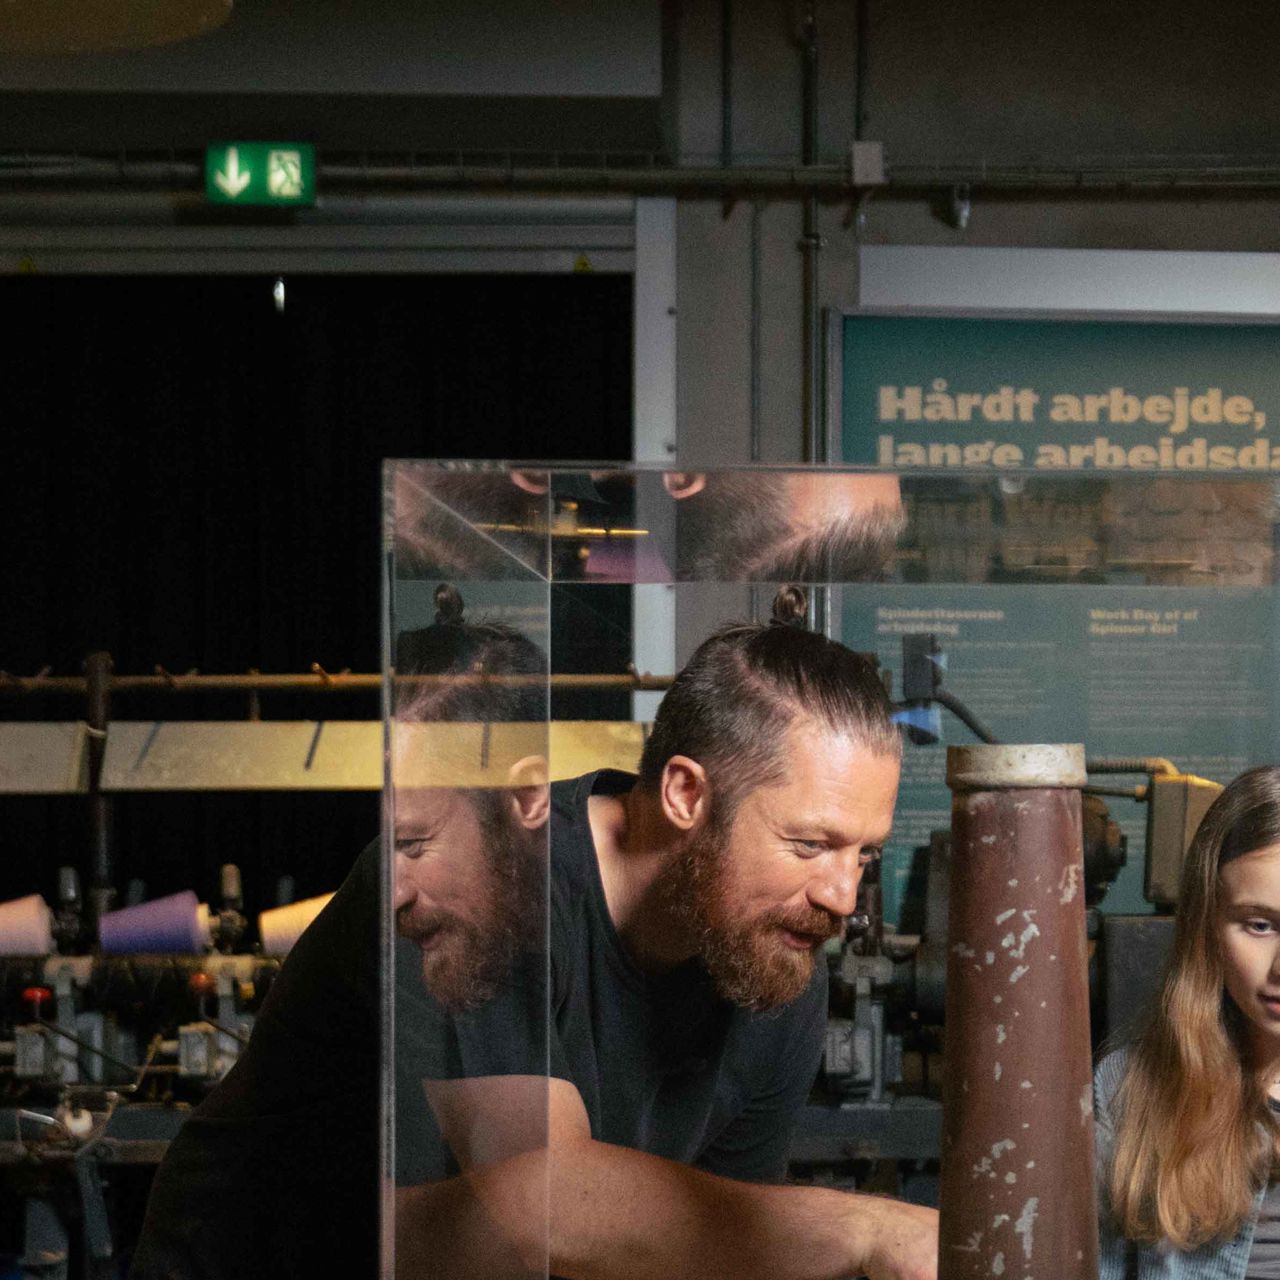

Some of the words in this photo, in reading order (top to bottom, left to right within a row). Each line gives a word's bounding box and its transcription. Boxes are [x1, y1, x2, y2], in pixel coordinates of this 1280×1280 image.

[879, 378, 1039, 422] Hårdt
[1049, 386, 1267, 433] arbejde,
[878, 435, 1024, 468] lange
